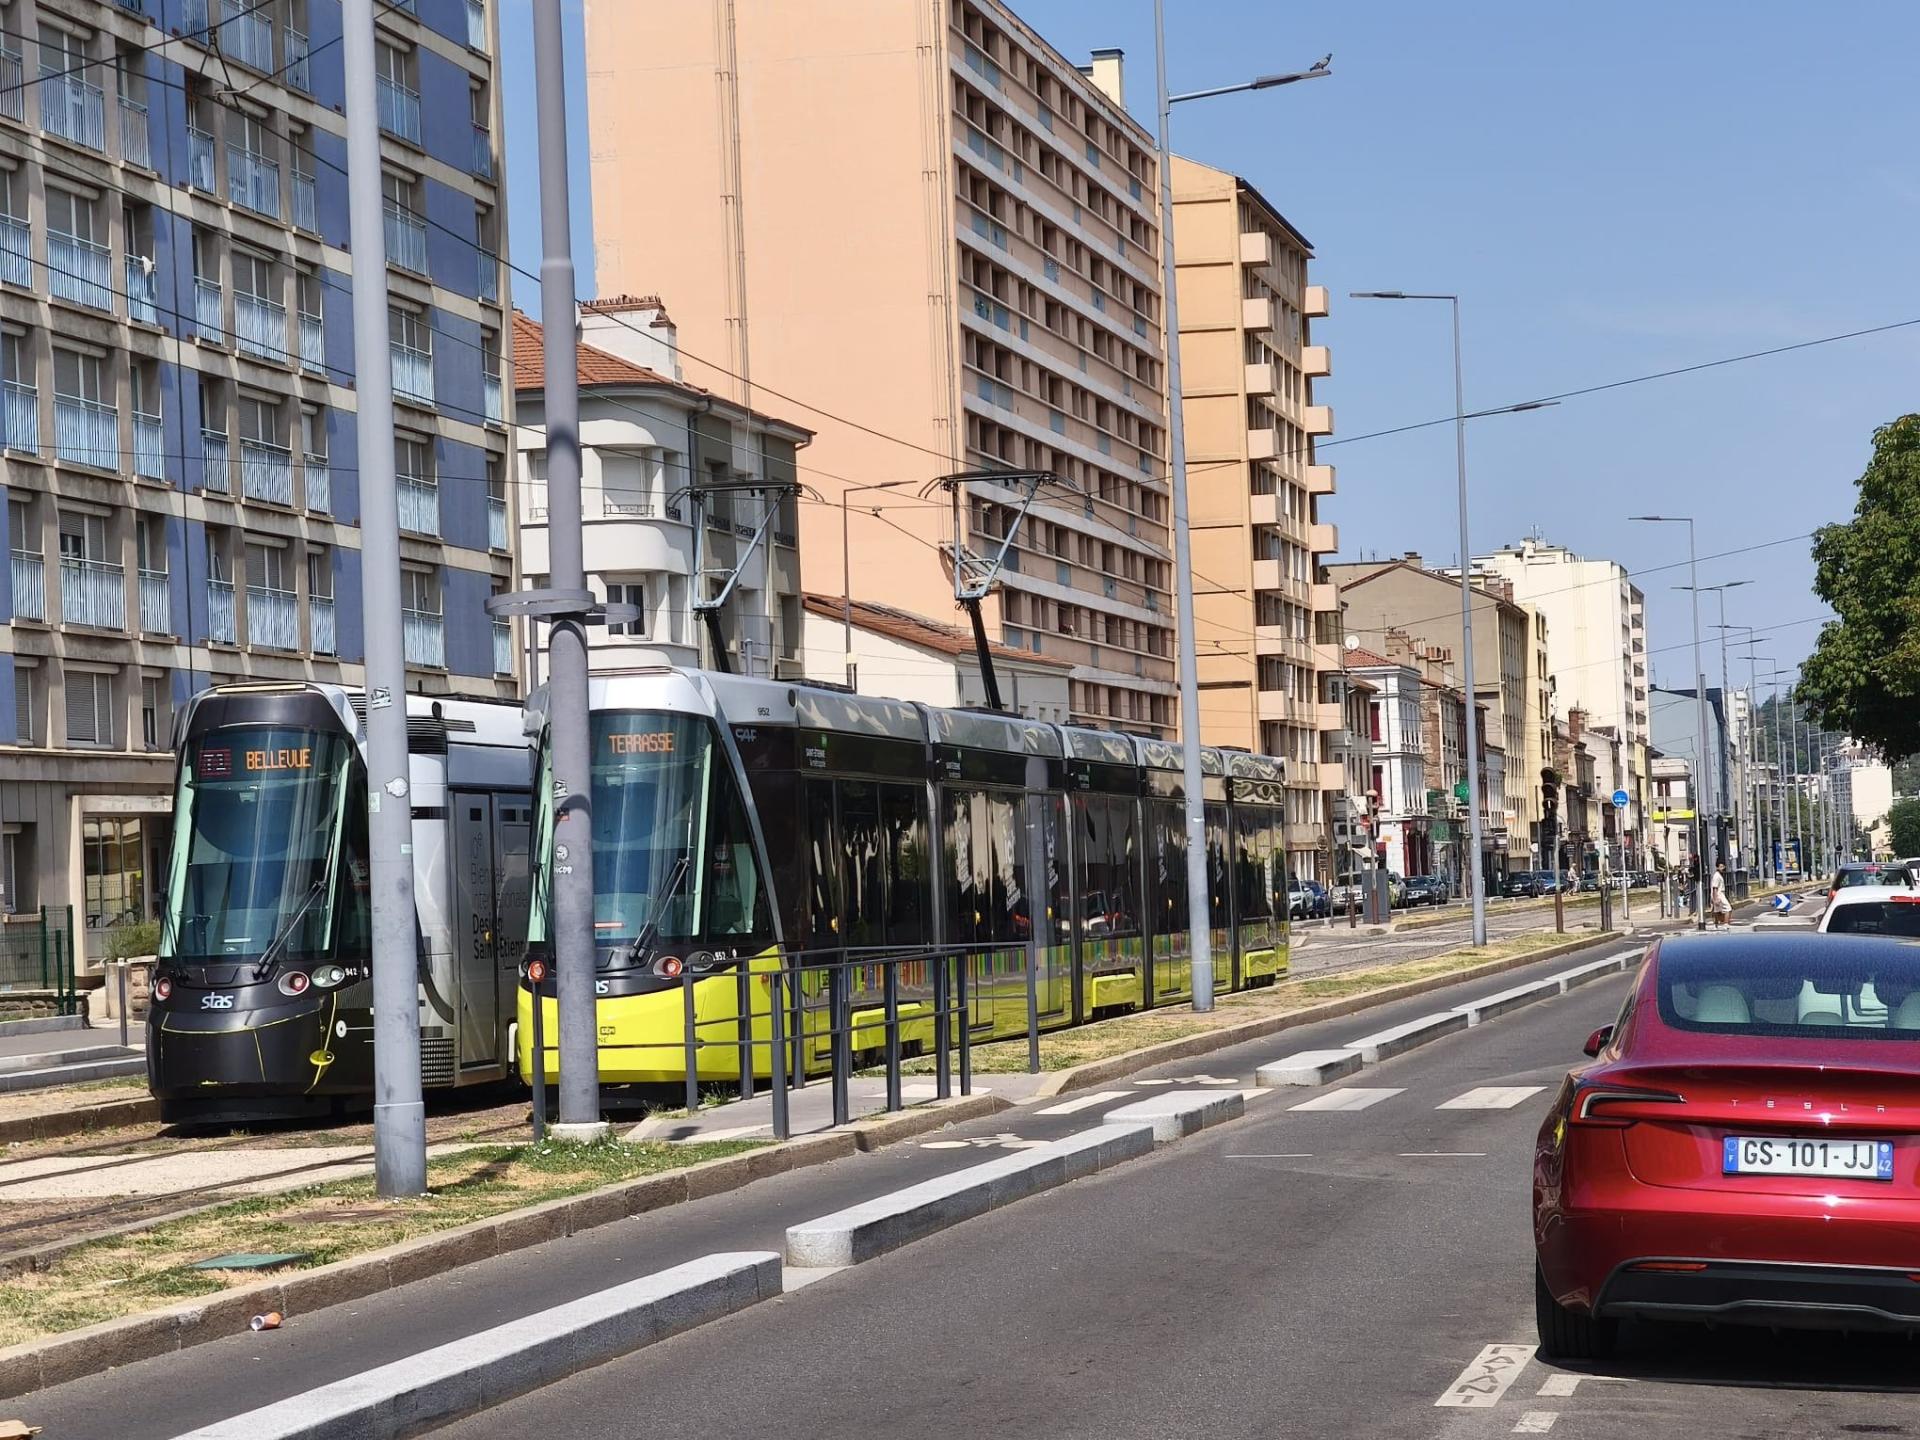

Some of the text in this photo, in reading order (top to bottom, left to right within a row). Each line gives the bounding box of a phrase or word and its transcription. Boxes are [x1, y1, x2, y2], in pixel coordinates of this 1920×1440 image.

[757, 707, 770, 716] 952
[608, 732, 675, 754] TERRASSE
[246, 748, 312, 770] BELLEVUE
[200, 991, 234, 1010] stas
[1731, 1099, 1886, 1113] TESLA
[1728, 1154, 1735, 1164] F
[1744, 1140, 1875, 1170] GS-101-JJ
[1877, 1159, 1893, 1173] 42
